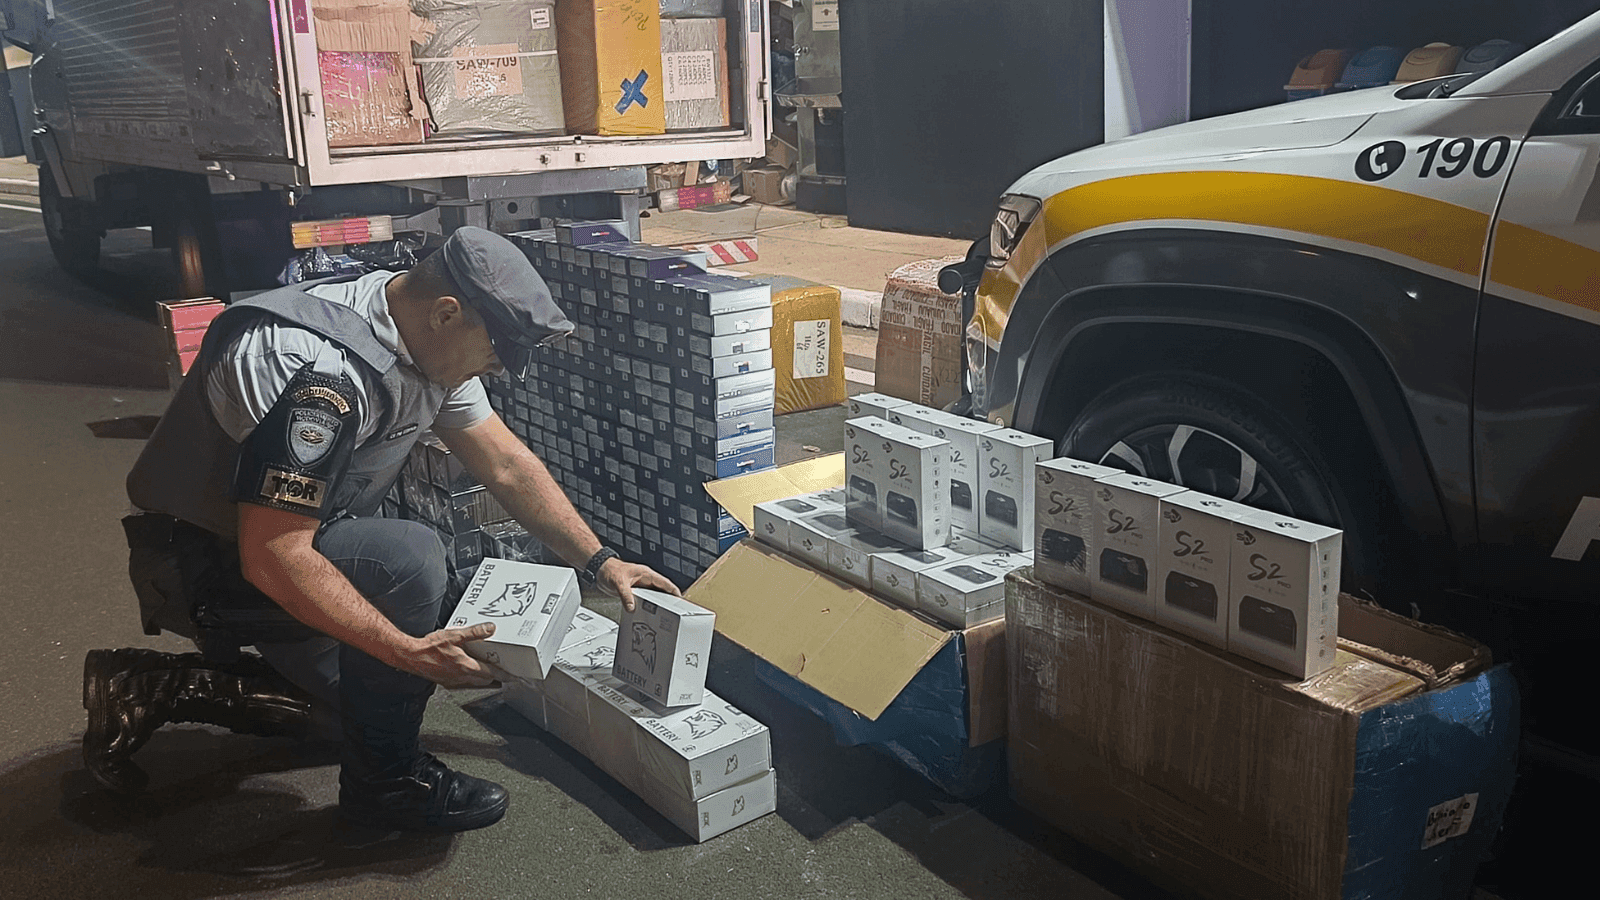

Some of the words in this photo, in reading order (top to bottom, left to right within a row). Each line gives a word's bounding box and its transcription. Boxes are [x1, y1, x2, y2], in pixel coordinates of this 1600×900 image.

[1416, 136, 1511, 178] 190
[816, 321, 826, 374] SAW-265
[852, 444, 871, 464] S2
[889, 458, 910, 479] S2
[989, 457, 1011, 478] S2
[272, 476, 318, 501] TOR
[1048, 491, 1079, 515] S2
[1106, 508, 1139, 534] S2
[1173, 530, 1210, 557] S2
[1247, 553, 1287, 581] S2
[466, 563, 496, 606] BATTERY
[617, 664, 648, 689] BATTERY
[597, 685, 629, 705] BATTERY
[646, 719, 682, 742] BATTERY
